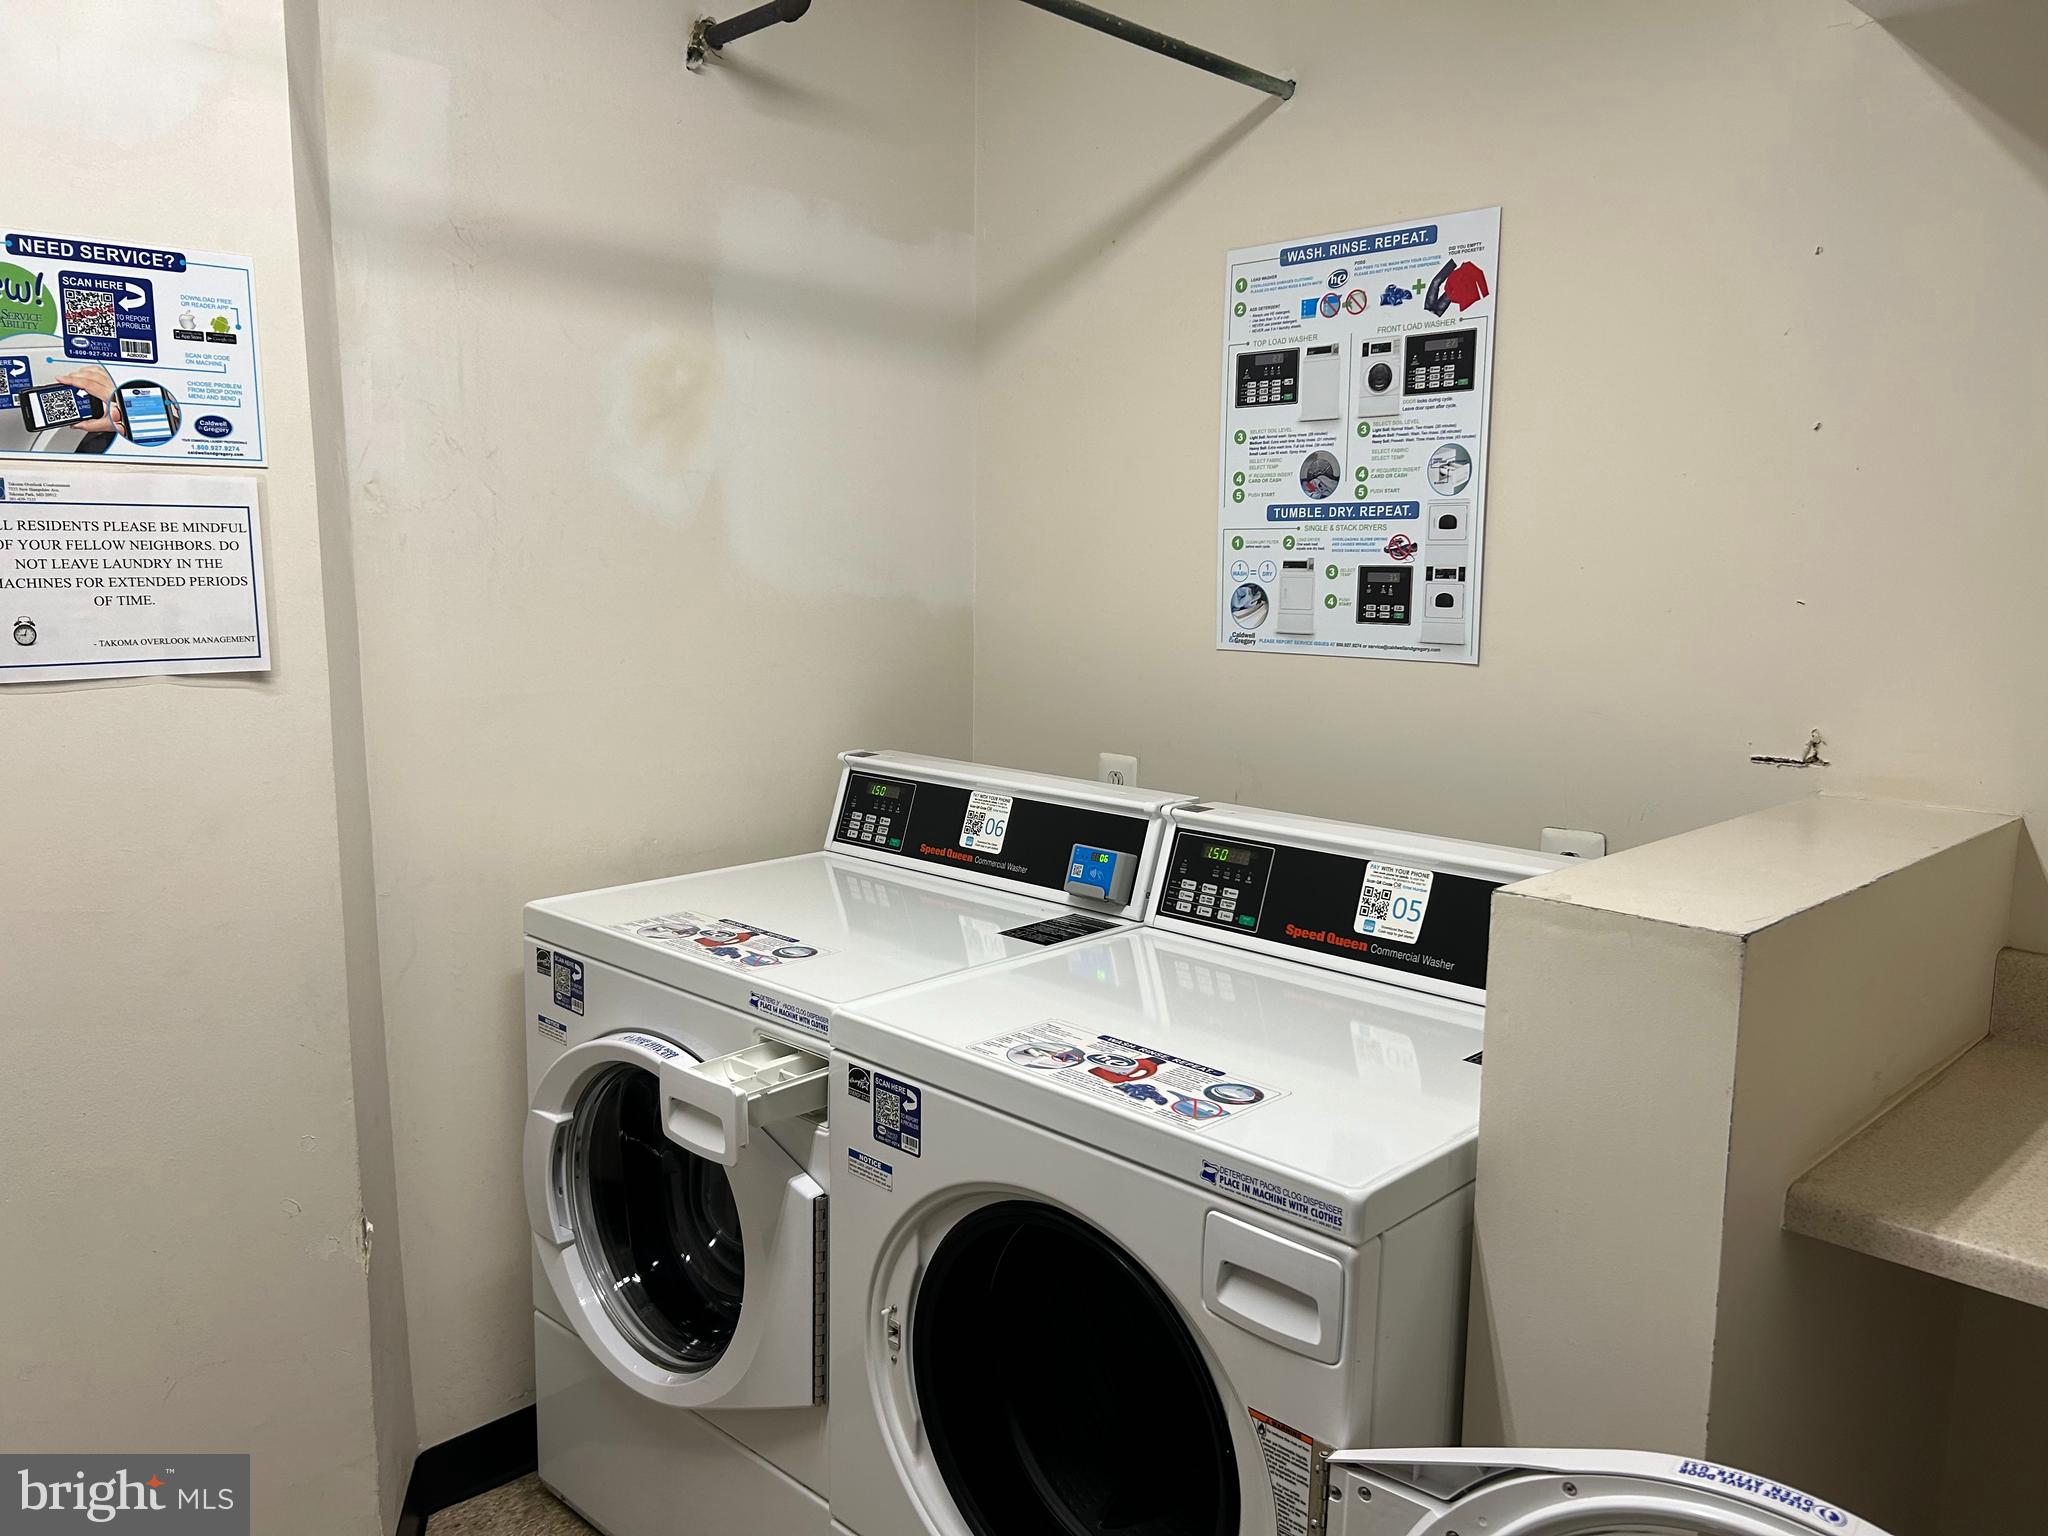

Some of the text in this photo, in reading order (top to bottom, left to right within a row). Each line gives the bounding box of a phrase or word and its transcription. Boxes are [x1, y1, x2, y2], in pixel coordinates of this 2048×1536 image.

[19, 238, 175, 268] NEED SERVICE?
[1287, 230, 1428, 263] WASH. RINSE. REPEAT.
[0, 272, 44, 305] w!
[62, 276, 124, 290] SCAN HERE
[180, 294, 215, 303] DOWNLOAD
[2, 309, 42, 321] SERVICE
[0, 319, 38, 329] ABILITY
[1377, 318, 1456, 333] FRONT LOAD WASHER
[1288, 334, 1318, 343] WASHER
[1274, 504, 1412, 519] TUMBLE. DRY. REPEAT.
[0, 520, 247, 534] L RESIDENTS PLEASE BE MINDFUL
[18, 539, 61, 551] YOUR
[66, 540, 126, 551] FELLOW
[130, 540, 215, 551] NEIGHBORS.
[219, 541, 239, 551] DO
[15, 558, 223, 570] NOT LEAVE LAUNDRY IN THE
[0, 576, 248, 590] ACHINES FOR EXTENDED PERIODS
[94, 595, 156, 607] OF TIME.
[99, 638, 139, 647] TAKOMA
[140, 637, 190, 646] OVERLOOK
[192, 635, 256, 644] MANAGEMENT
[1234, 637, 1256, 645] Gregory
[985, 818, 1005, 837] 06
[920, 843, 1028, 875] Speed Queen Commercial Washer
[1100, 854, 1109, 863] 06
[1411, 871, 1430, 879] PHONE
[1392, 897, 1422, 922] 05
[1285, 924, 1455, 971] Speed Queen Commercial Washer
[760, 995, 781, 1007] DETERG
[760, 1001, 772, 1011] PLACE
[779, 1008, 798, 1021] MACHINE
[799, 1015, 810, 1025] WITH
[811, 1019, 829, 1032] CLOTHES
[875, 1077, 906, 1095] SCAN HERE
[859, 1153, 882, 1169] NOTICE
[1220, 1166, 1343, 1216] DETERGENT PACKS CLOG DISPENSER
[1220, 1175, 1342, 1226] PLACE IN MACHINE WITH CLOTHES
[1679, 1468, 1810, 1512] PLEASE LEAVE DOOR
[1682, 1461, 1813, 1506] OPEN AFTER USE
